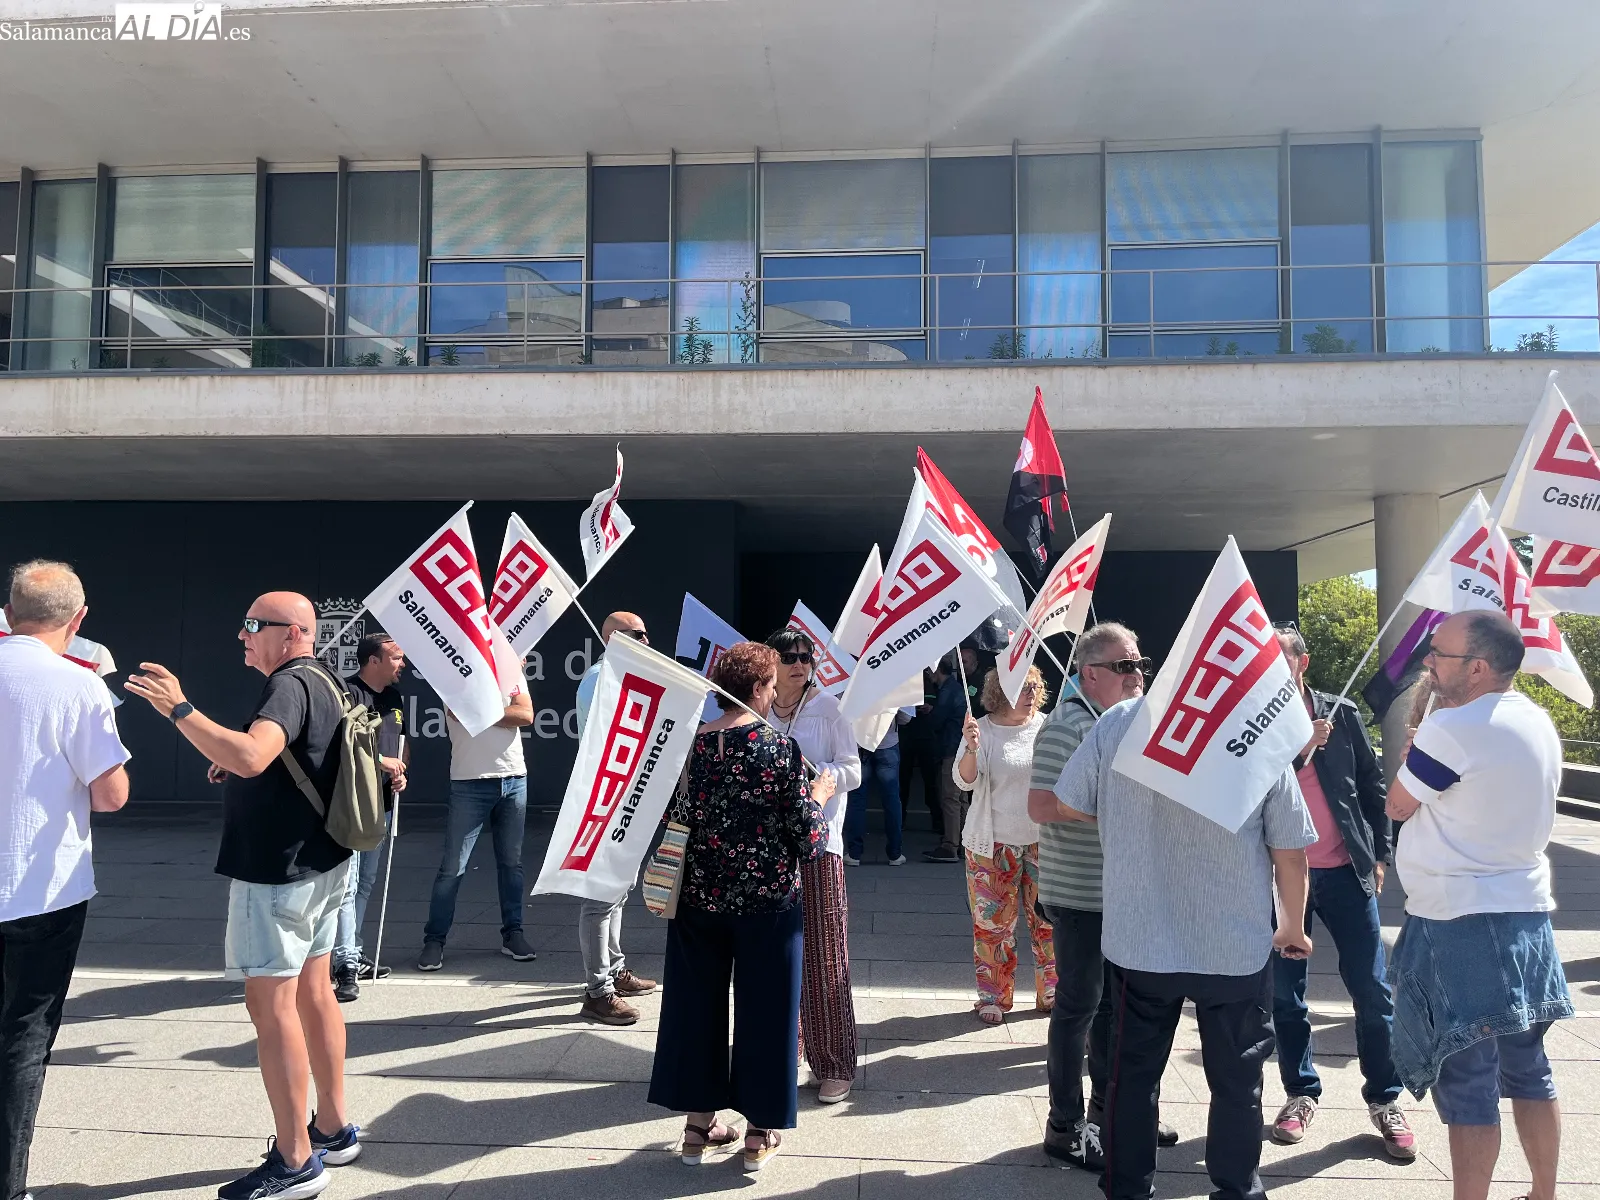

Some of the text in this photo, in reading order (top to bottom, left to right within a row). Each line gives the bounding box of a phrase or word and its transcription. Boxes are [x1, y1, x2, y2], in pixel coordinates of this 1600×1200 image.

[398, 589, 474, 679] Salamanca
[506, 586, 555, 644] alamanca
[866, 600, 962, 670] Salamanca
[611, 717, 676, 843] Salamanca
